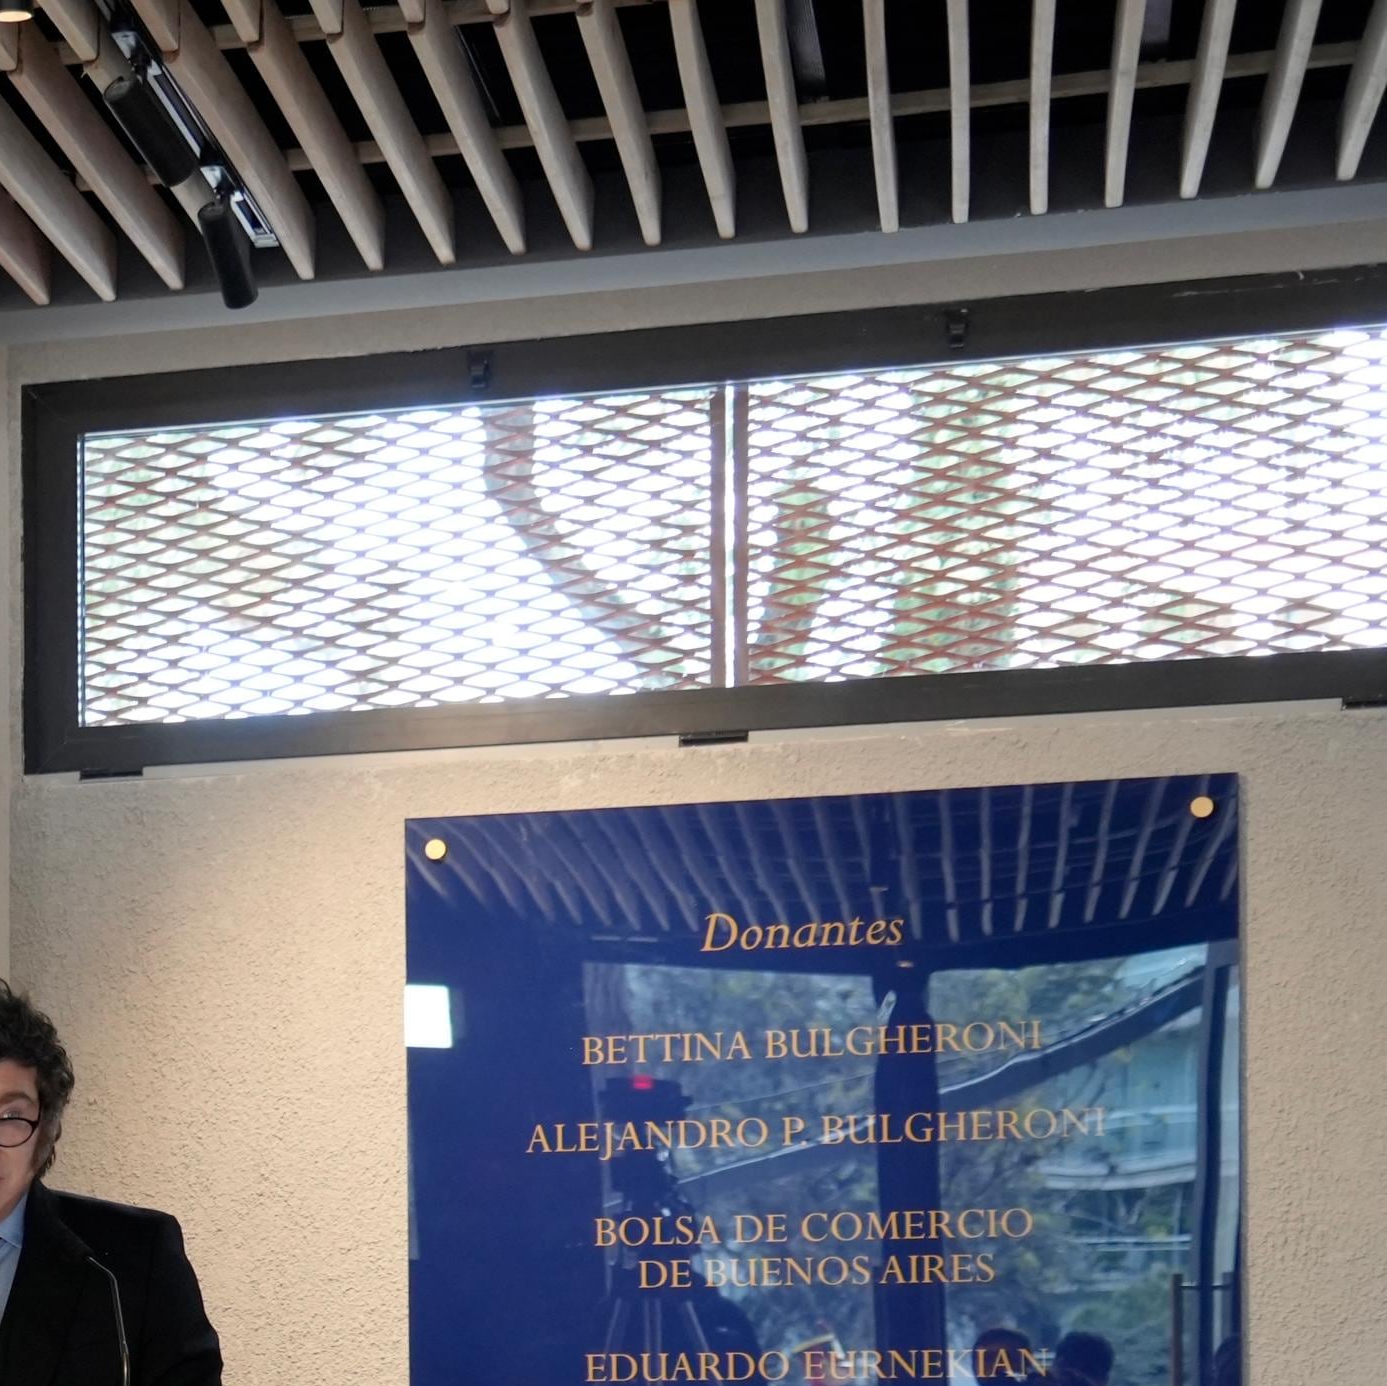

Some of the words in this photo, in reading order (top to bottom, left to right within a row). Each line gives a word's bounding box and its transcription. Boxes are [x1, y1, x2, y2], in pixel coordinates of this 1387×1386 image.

[700, 912, 904, 952] Donantes
[581, 1031, 751, 1065] BETTINA
[765, 1019, 1042, 1059] BULGHERONI
[526, 1117, 768, 1161] ALEJANDRO
[782, 1118, 807, 1148] P.
[822, 1105, 1107, 1146] BULGHERONI
[593, 1214, 723, 1248] BOLSA
[734, 1213, 789, 1243] DE
[801, 1207, 1035, 1243] COMERCIO
[638, 1259, 693, 1289] DE
[704, 1255, 872, 1288] BUENOS
[879, 1253, 997, 1286] AIRES
[585, 1351, 790, 1382] EDUARDO
[804, 1348, 1050, 1380] EURNEKIAN
